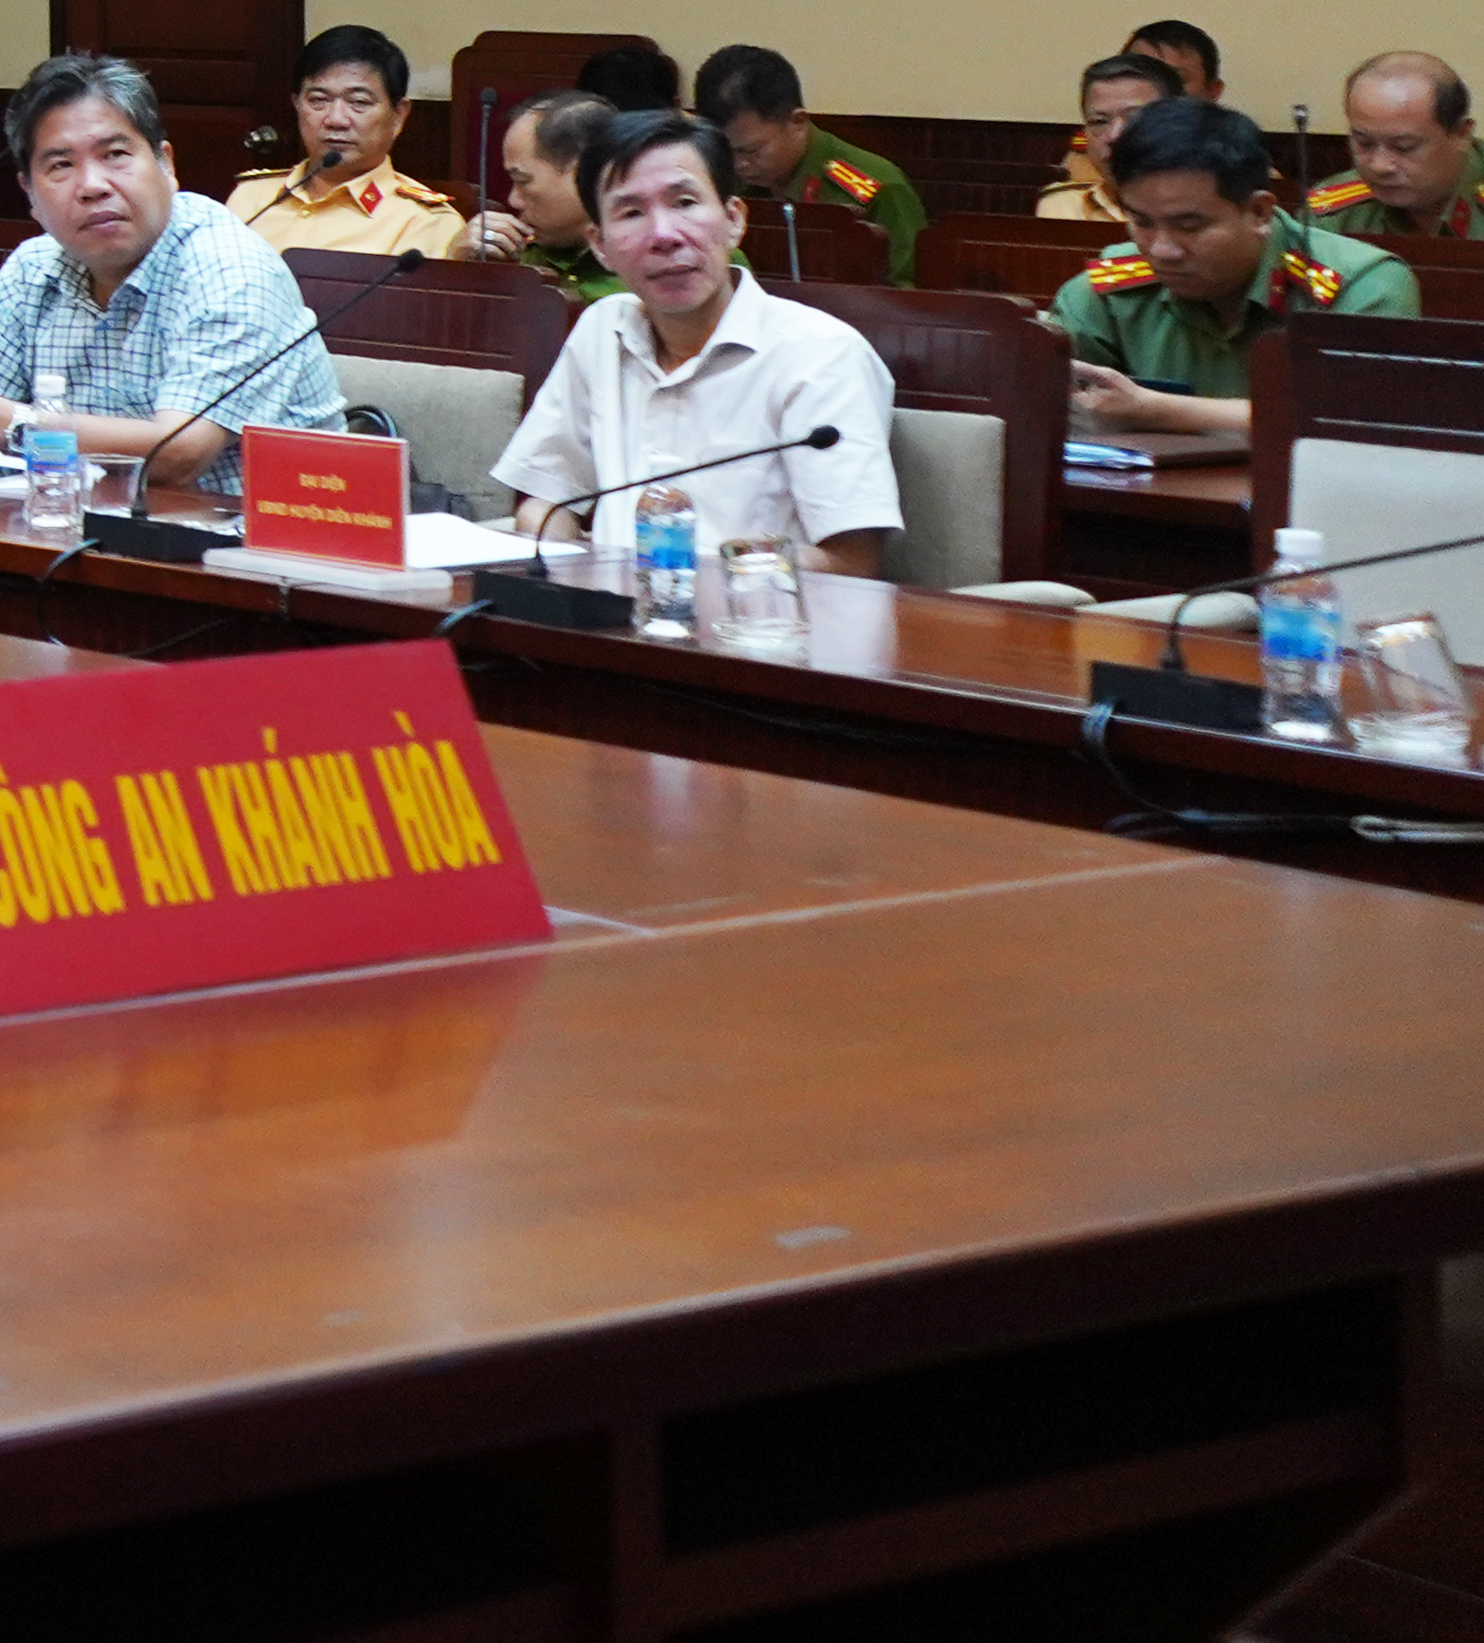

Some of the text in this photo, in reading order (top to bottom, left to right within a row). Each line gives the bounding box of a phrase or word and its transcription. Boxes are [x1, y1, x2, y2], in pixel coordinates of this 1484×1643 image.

[117, 772, 211, 904] AN
[200, 729, 389, 894] KHÁNH
[374, 713, 497, 872] HÒA
